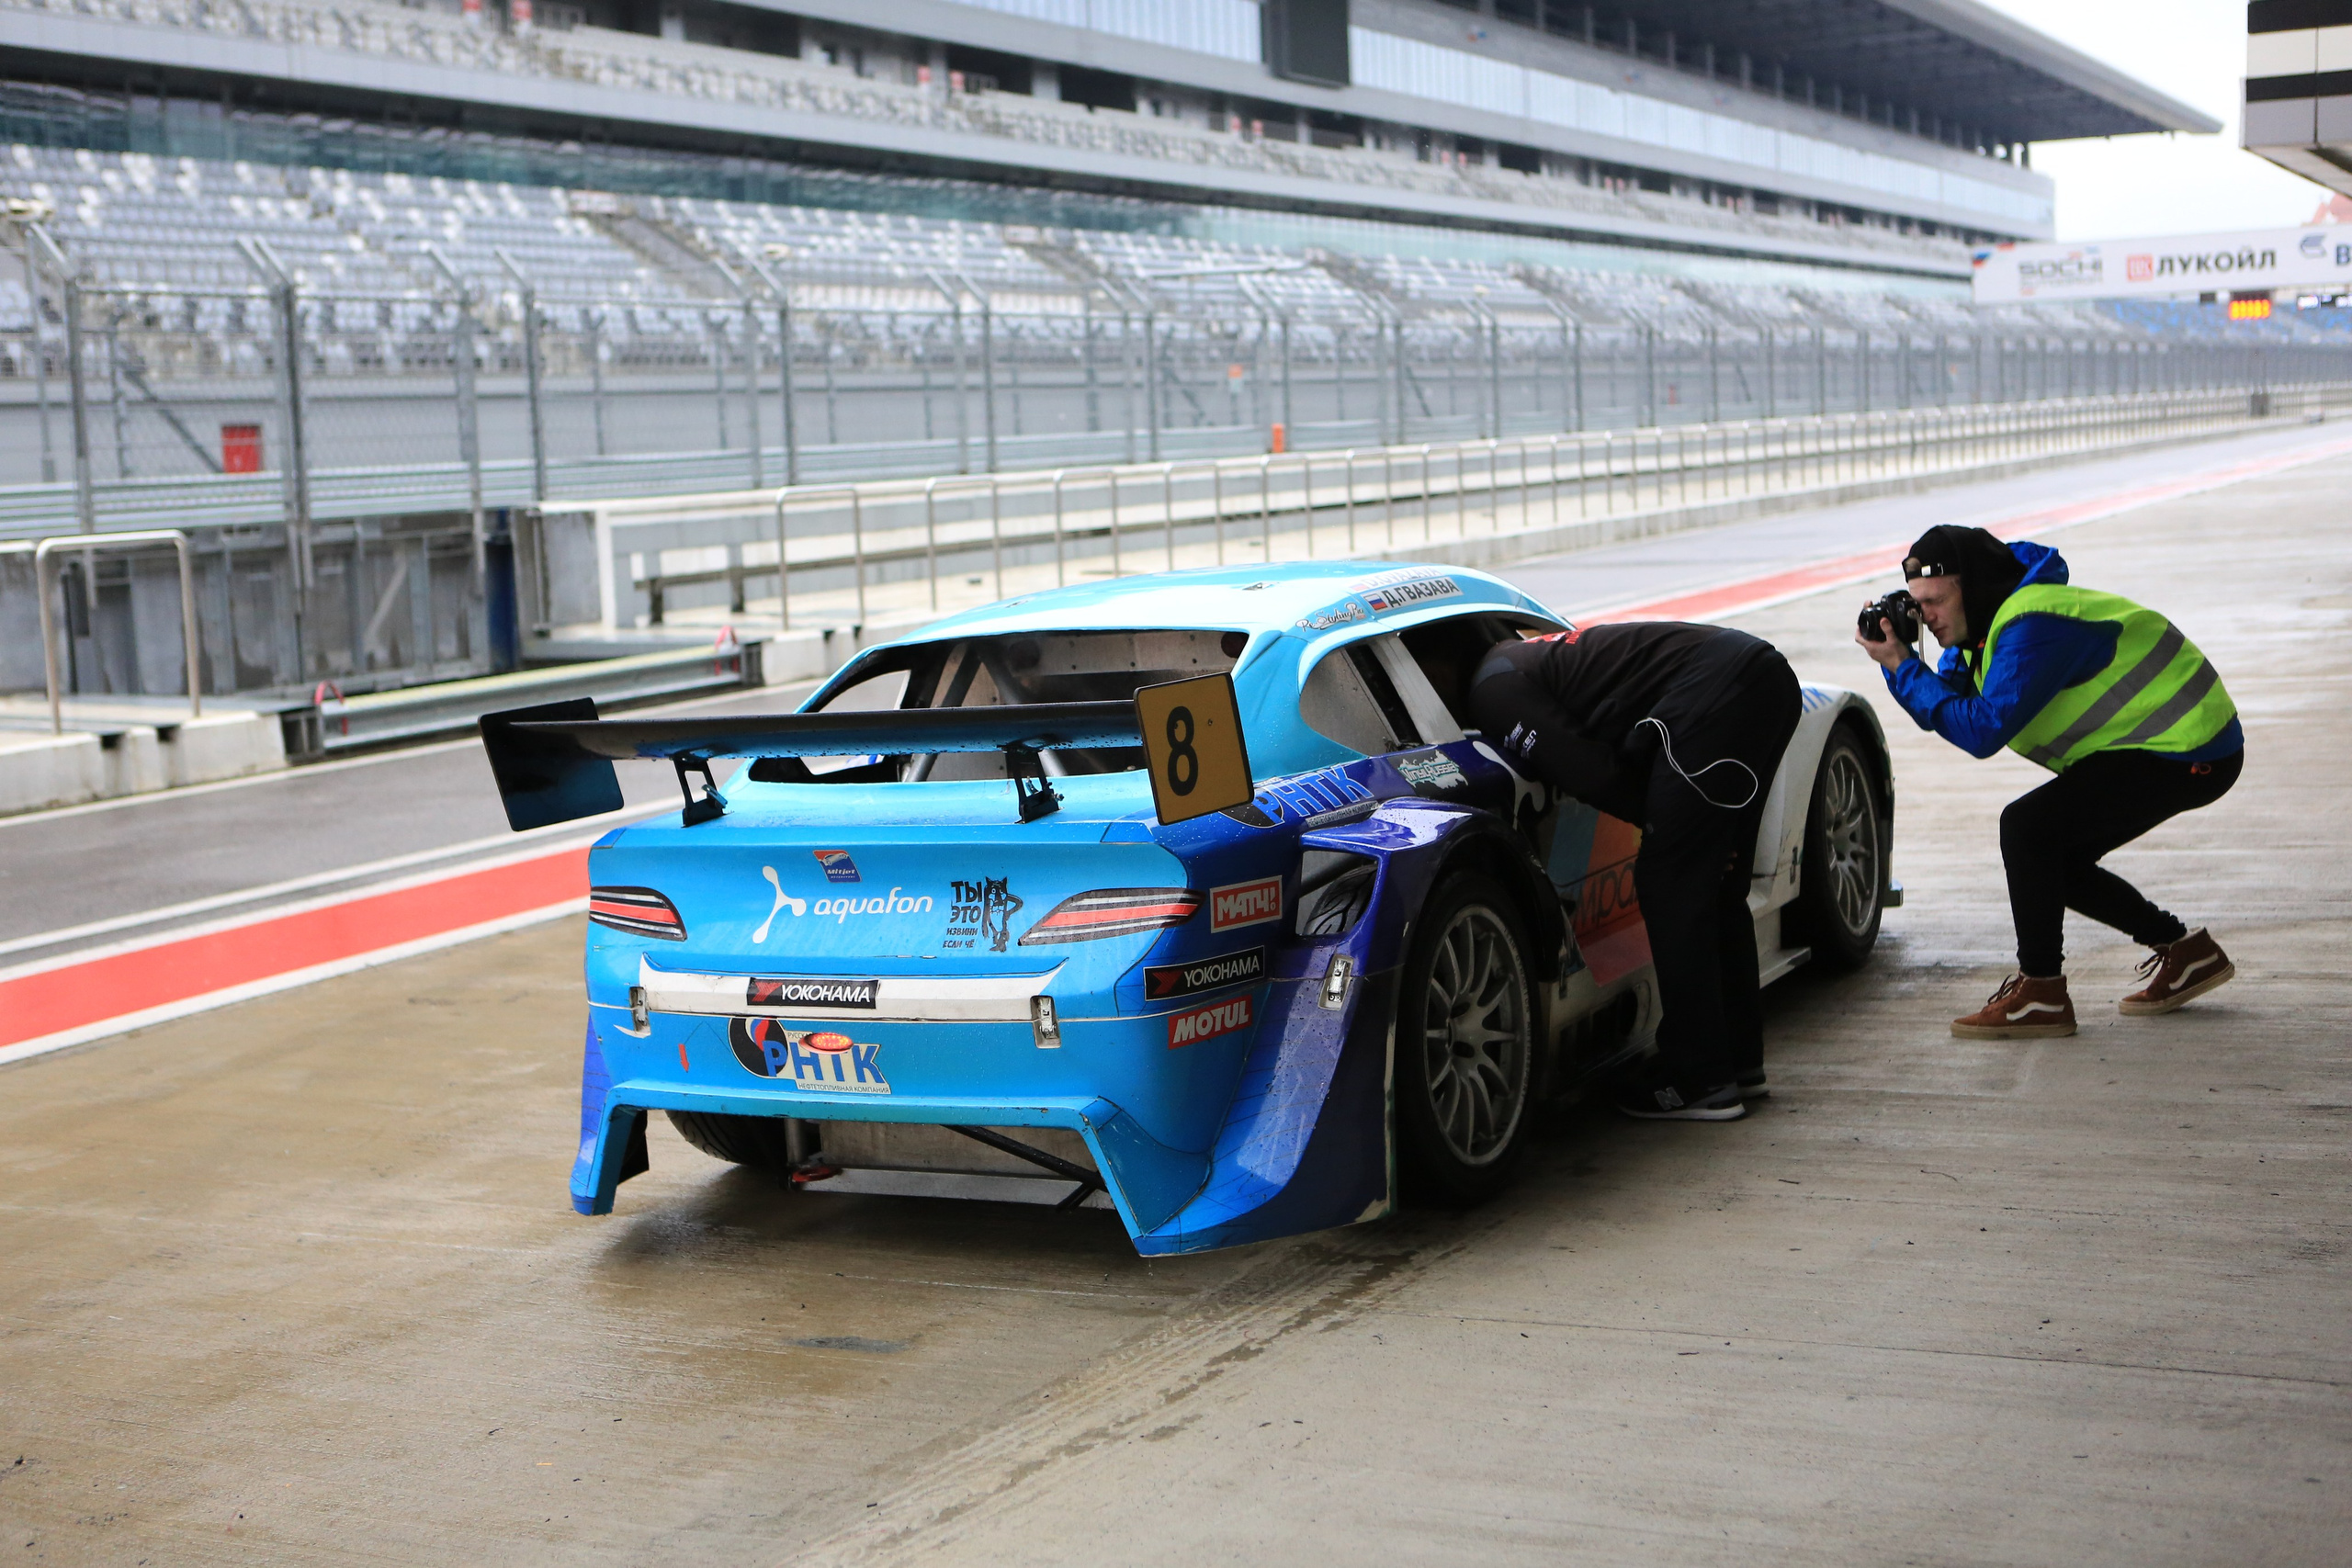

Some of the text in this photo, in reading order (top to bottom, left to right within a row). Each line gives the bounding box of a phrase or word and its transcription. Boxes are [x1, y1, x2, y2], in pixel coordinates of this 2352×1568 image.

[2018, 258, 2103, 276] SOCHI
[2157, 245, 2276, 276] ЛУКОЙЛ
[1381, 578, 1461, 608] Д.ГВАЗАВА
[1166, 705, 1199, 796] 8
[1250, 763, 1375, 826] РНТК
[814, 886, 933, 924] aquafon
[951, 880, 983, 903] ТЫ
[1216, 886, 1276, 922] МАТЧ!
[950, 905, 982, 924] ЭТО
[943, 940, 963, 949] ЕСЛИ
[946, 927, 978, 936] ИЗВИНИ
[1184, 955, 1261, 988] YOKOHAMA
[782, 984, 871, 1003] YOKOHAMA
[1172, 1000, 1250, 1044] MOTUL
[762, 1040, 886, 1084] РНТК
[798, 1083, 889, 1094] НЕФТЕТОПЛИВНАЯ КОМПАНИЯ
